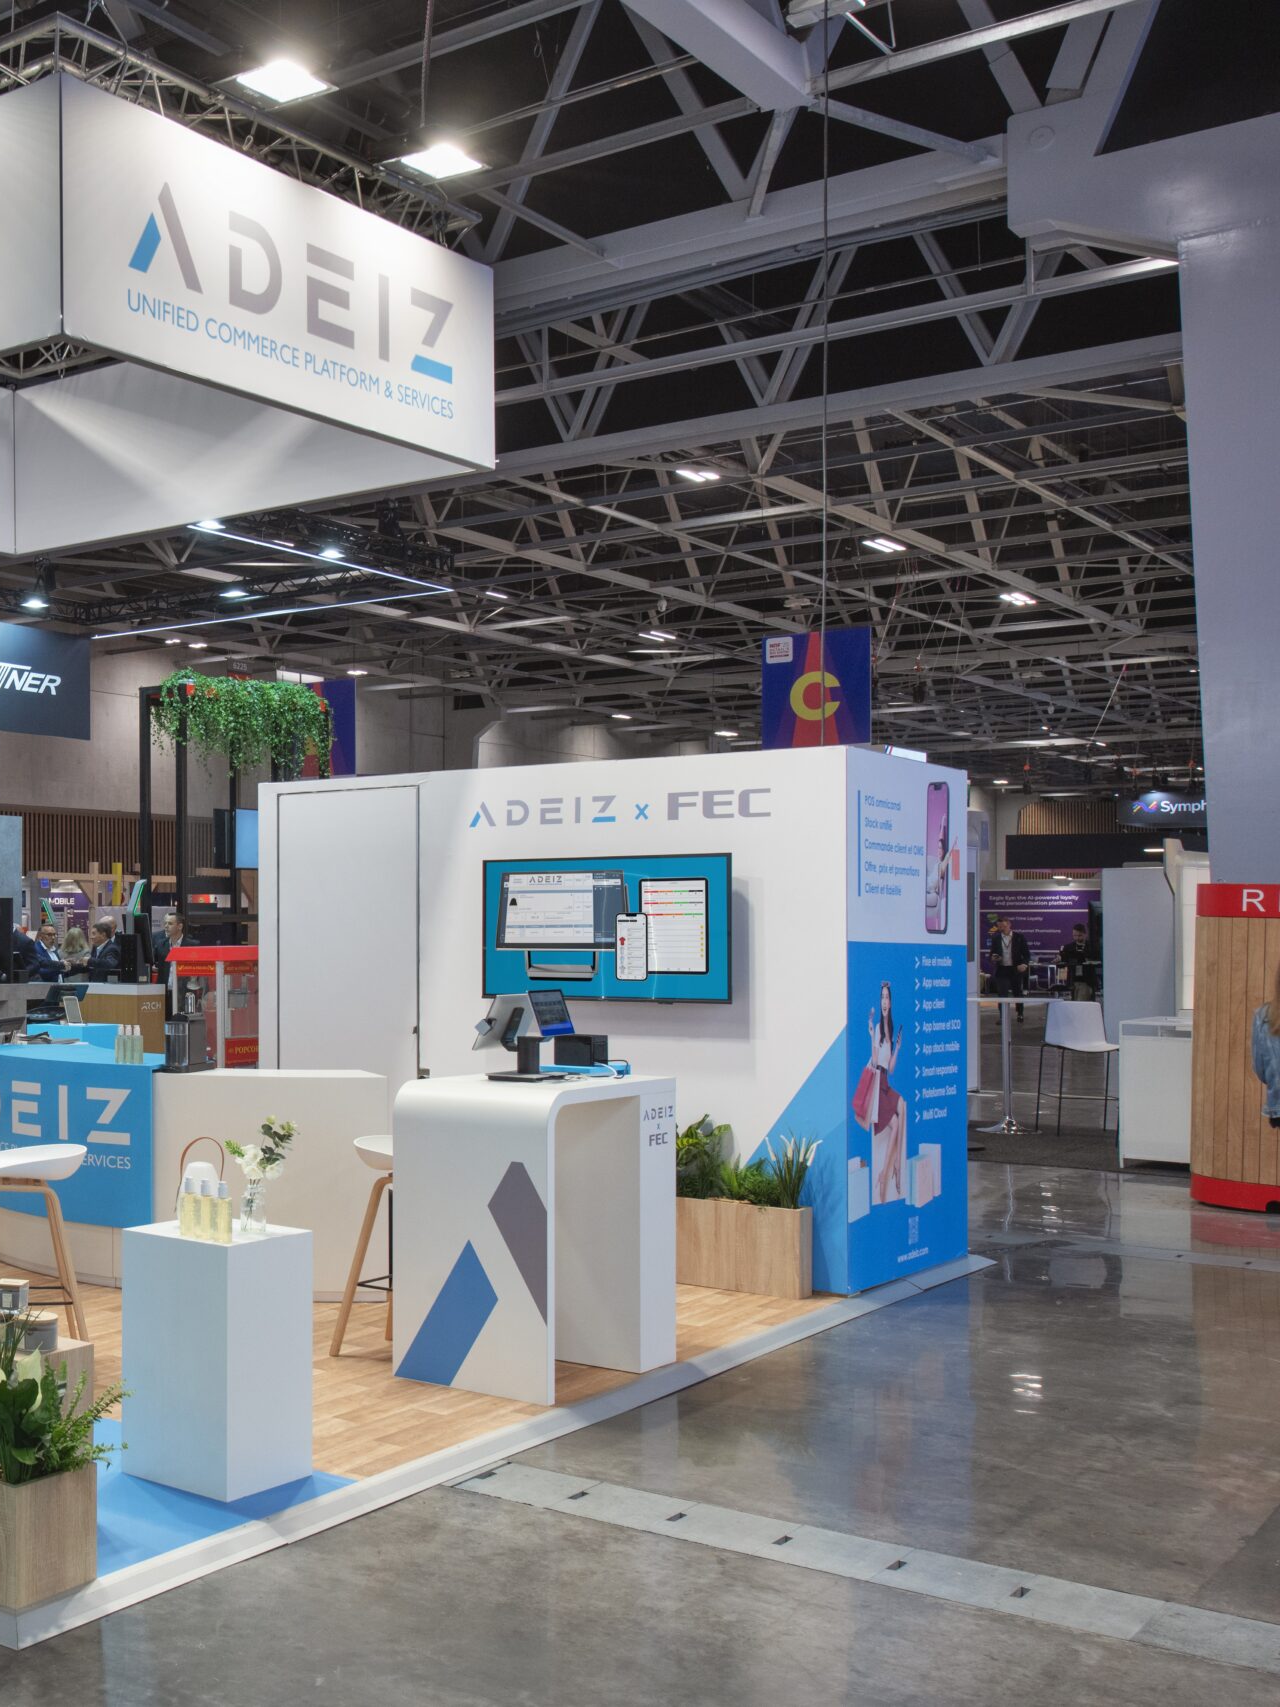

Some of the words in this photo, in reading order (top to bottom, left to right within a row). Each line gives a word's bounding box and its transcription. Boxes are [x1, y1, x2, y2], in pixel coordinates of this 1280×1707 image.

[128, 181, 453, 384] ADEIZ
[127, 288, 200, 332] UNIFIED
[205, 318, 300, 368] COMMERCE
[304, 351, 380, 395] PLATFORM
[384, 381, 394, 399] &
[396, 384, 455, 420] SERVICES
[790, 671, 840, 720] C
[469, 795, 616, 828] ADEIZ
[667, 788, 771, 820] FEC
[643, 1105, 674, 1121] ADEIZ
[648, 1132, 669, 1147] FEC
[81, 1153, 132, 1169] ERVICES
